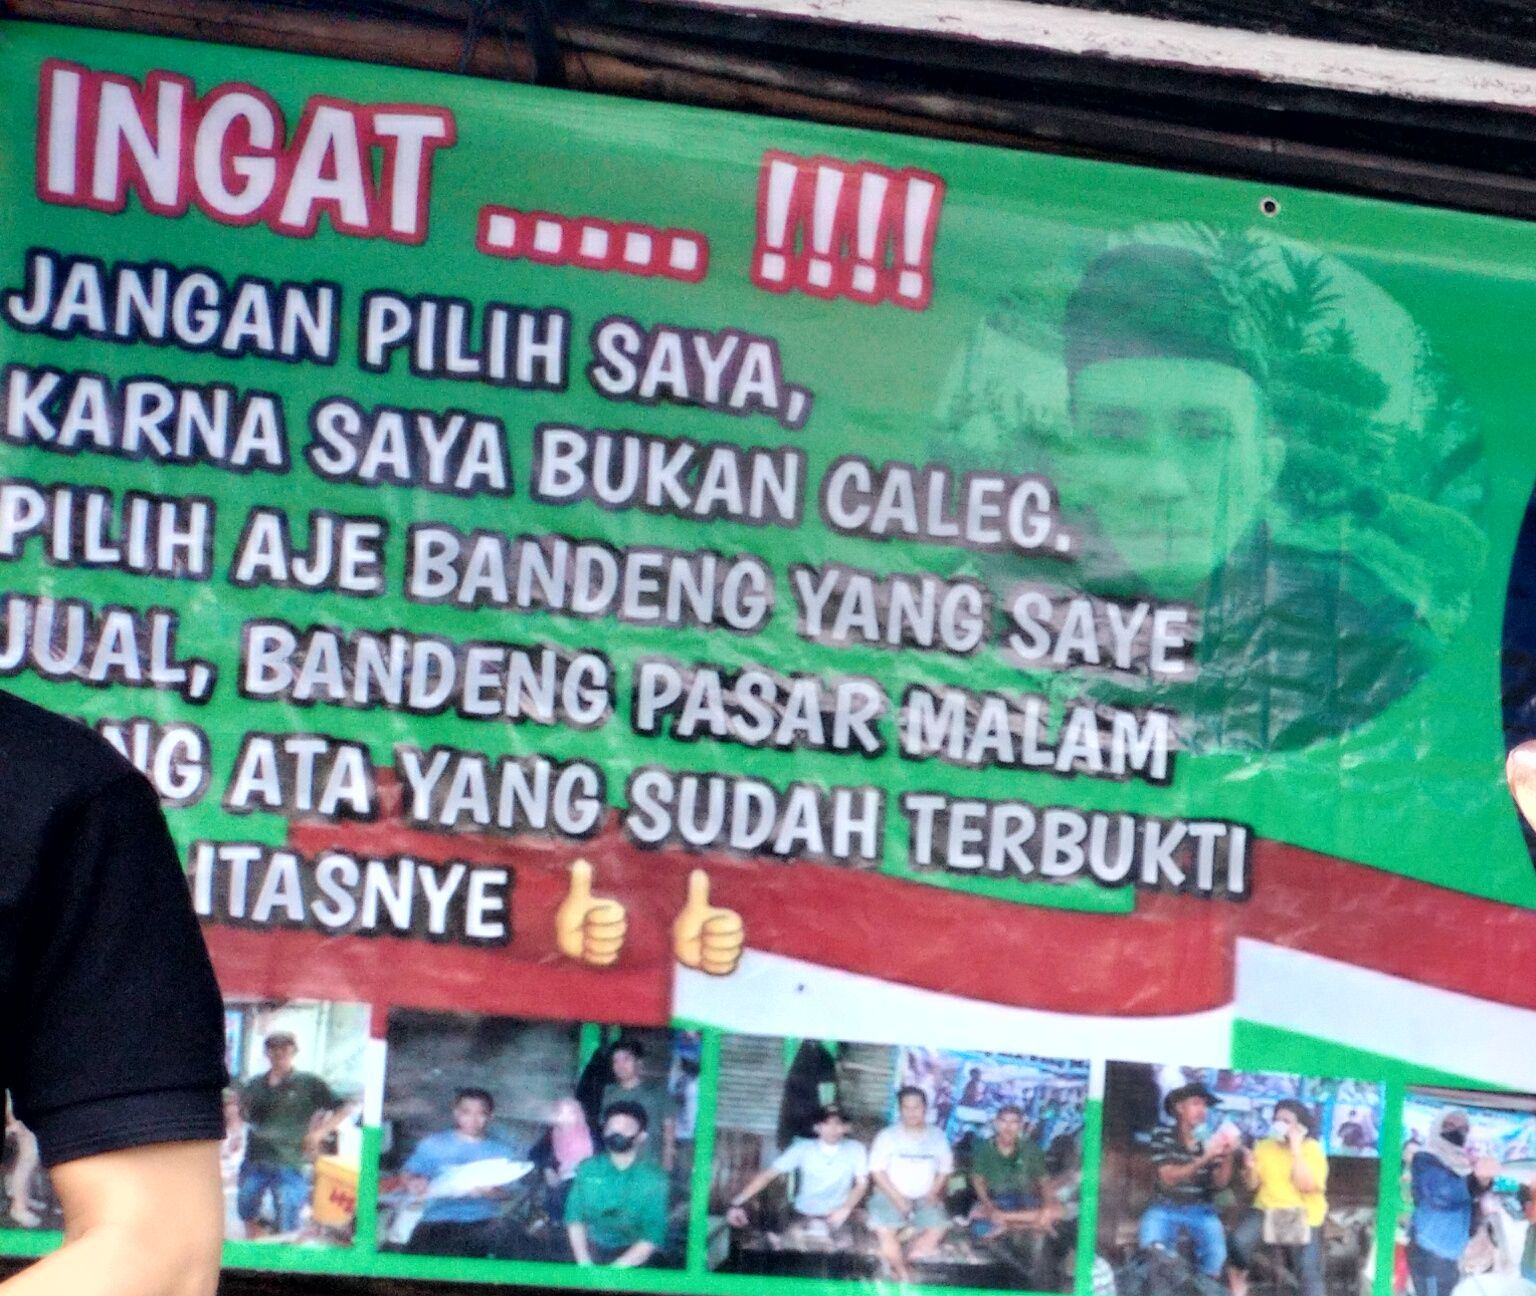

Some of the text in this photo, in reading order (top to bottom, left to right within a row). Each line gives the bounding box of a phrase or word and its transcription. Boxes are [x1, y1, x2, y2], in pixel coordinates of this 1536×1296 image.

[44, 64, 452, 240] INGAT
[7, 255, 808, 424] JANGAN PILIH SAYA,
[6, 369, 1072, 554] KARNA SAYA BUKAN CALEG.
[0, 485, 1190, 674] PILIH AJE BANDENG YANG SAYE
[0, 597, 1169, 780] JUAL, BANDENG PASAR MALAM
[191, 843, 508, 939] ITASNYE
[224, 735, 371, 815] ATA
[400, 747, 602, 836] YANG
[625, 770, 879, 860] SUDAH
[904, 794, 1248, 893] TERBUKTI
